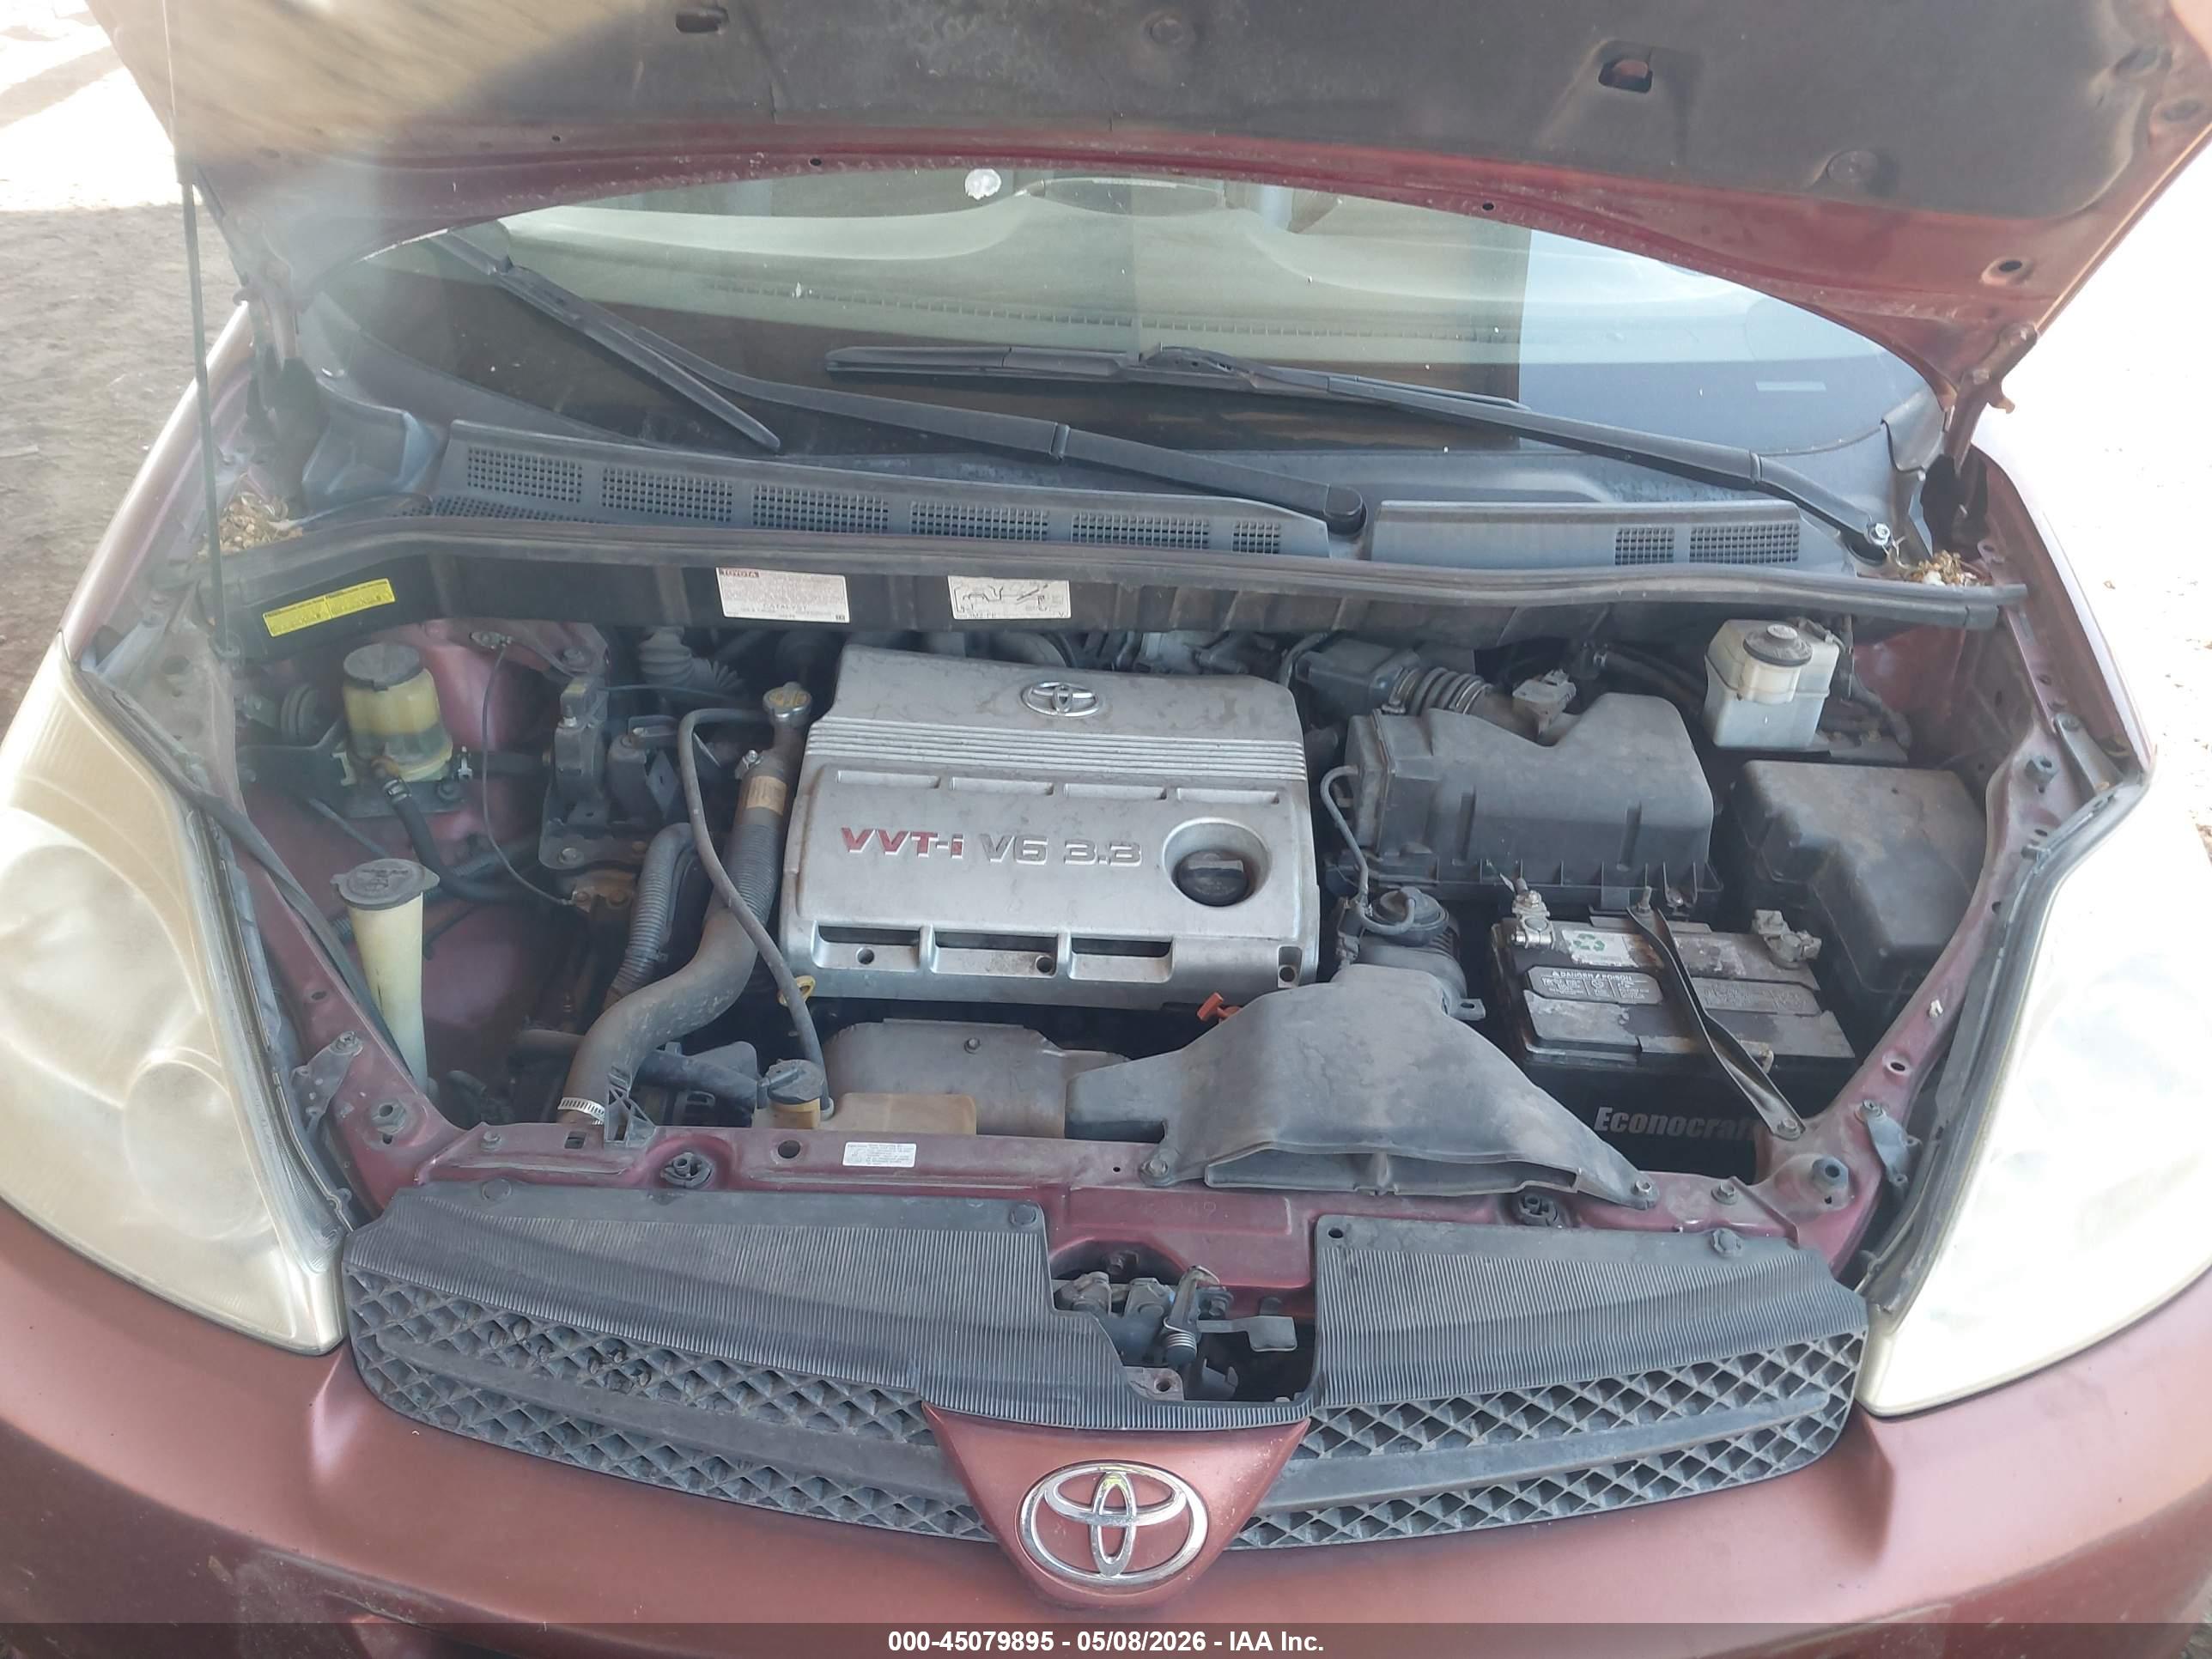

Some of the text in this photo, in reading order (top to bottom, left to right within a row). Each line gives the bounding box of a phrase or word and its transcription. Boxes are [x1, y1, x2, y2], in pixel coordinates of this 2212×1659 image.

[841, 826, 1142, 867] VVT-i V6 3.3
